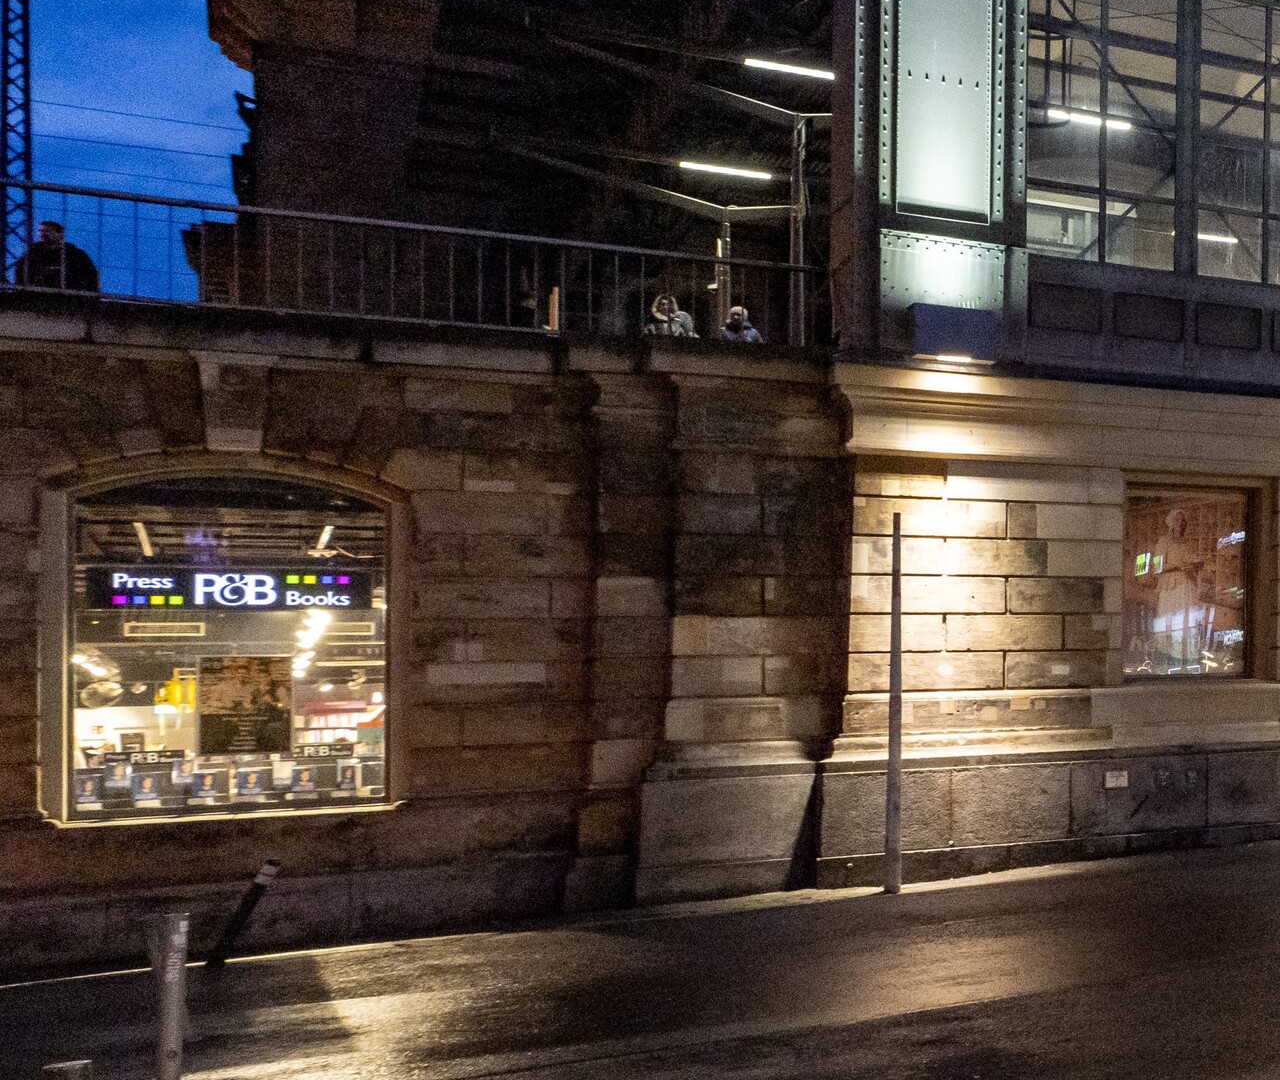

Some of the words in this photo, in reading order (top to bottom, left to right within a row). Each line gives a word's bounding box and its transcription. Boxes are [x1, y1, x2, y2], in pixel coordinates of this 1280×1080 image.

[112, 573, 174, 589] Press
[194, 573, 278, 606] P&B
[285, 591, 350, 606] Books
